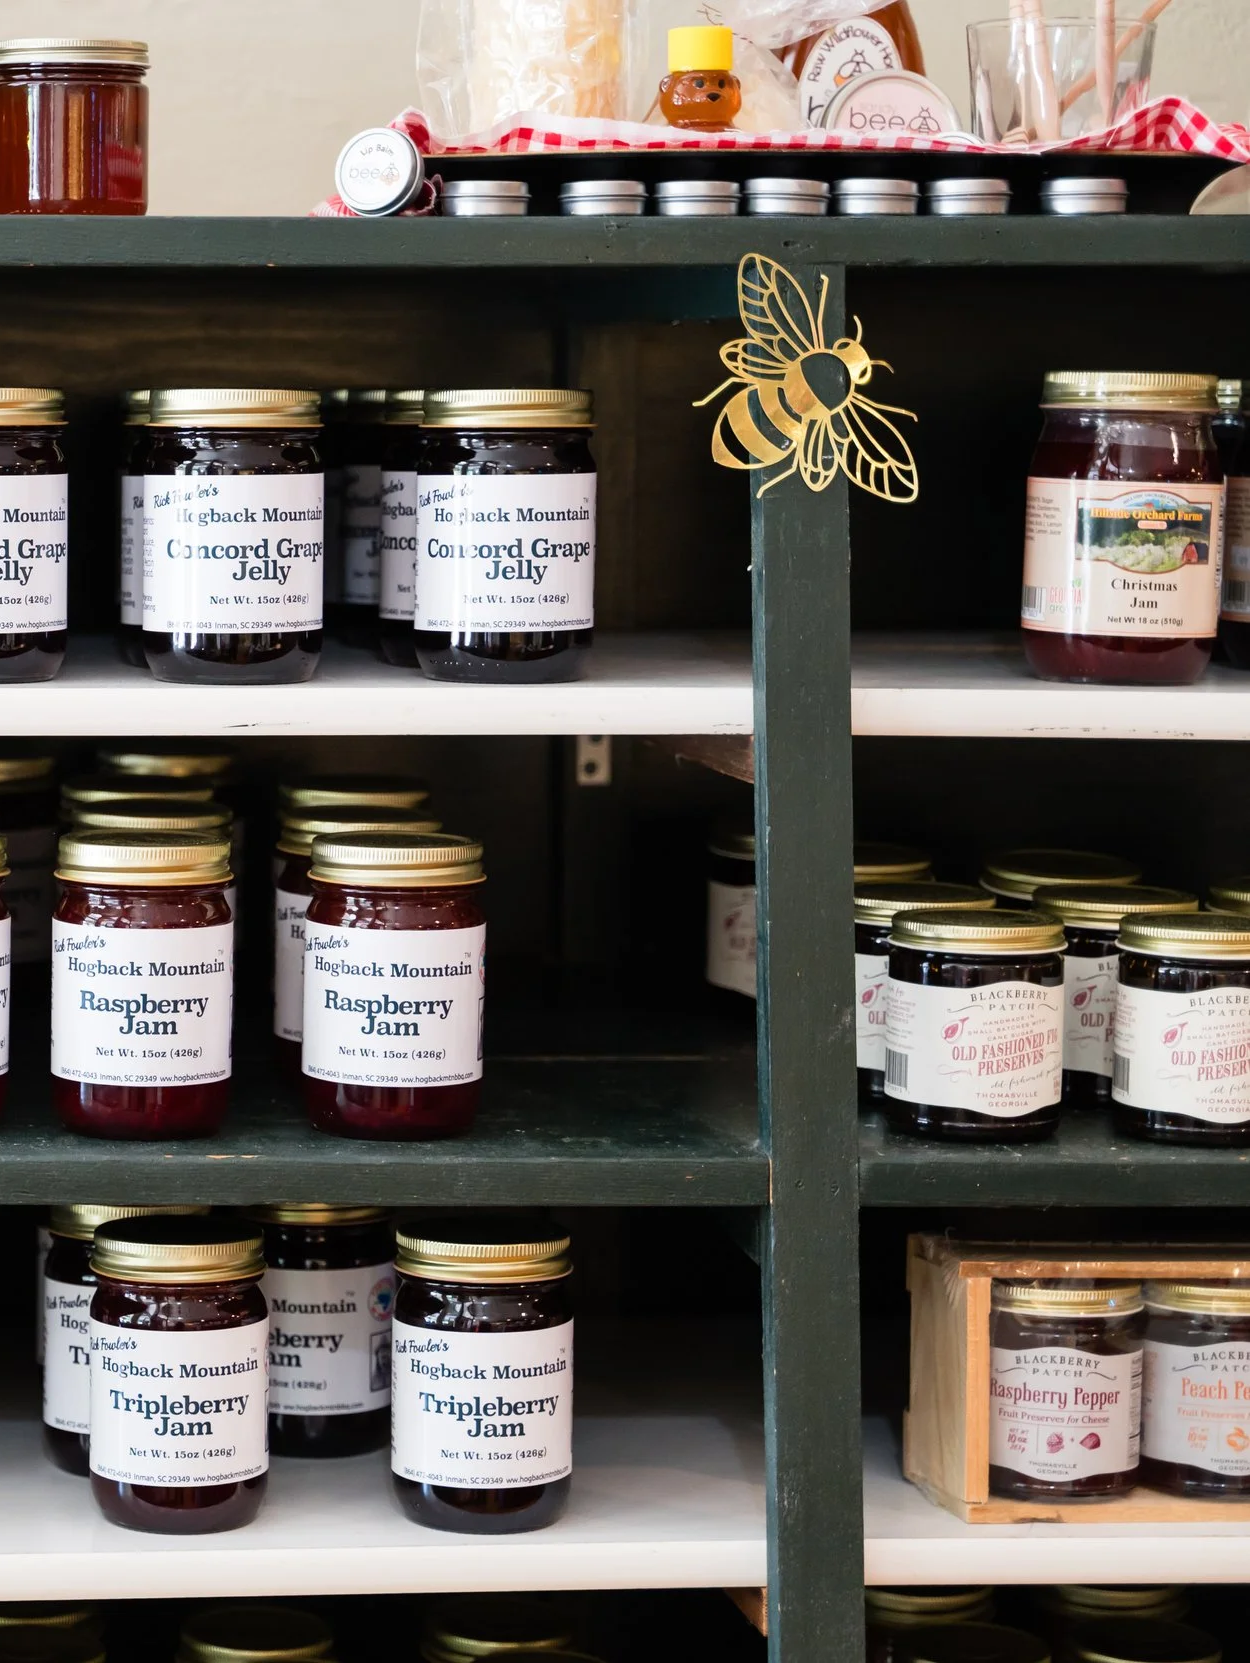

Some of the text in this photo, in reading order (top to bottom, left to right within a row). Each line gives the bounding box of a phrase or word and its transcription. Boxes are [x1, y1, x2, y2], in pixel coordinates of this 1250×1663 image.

[807, 25, 882, 82] Raw Wildflower
[850, 107, 905, 130] bee
[349, 165, 380, 178] bee
[262, 506, 322, 522] Mountain
[516, 506, 590, 522] Mountain
[1090, 507, 1203, 521] Hillside Orchard Farms
[17, 539, 66, 563] Grape
[167, 538, 270, 559] Concord
[428, 538, 590, 562] Concord Grape
[232, 560, 291, 585] Jelly
[485, 560, 547, 584] Jelly
[1111, 578, 1178, 592] Christmas
[510, 595, 535, 604] 15oz
[1130, 597, 1158, 609] Jam
[251, 621, 272, 629] 29349
[1107, 616, 1121, 624] Net
[1161, 617, 1183, 627] (510g)
[67, 936, 106, 950] Fowler's
[68, 957, 225, 977] Hogback Mountain
[315, 956, 472, 978] Hogback Mountain
[79, 990, 209, 1018] Raspberry
[324, 989, 453, 1019] Raspberry
[970, 989, 1049, 1002] BLACKBERRY
[989, 1003, 1035, 1011] PATCH
[119, 1016, 178, 1035] Jam
[361, 1016, 420, 1036] Jam
[952, 1046, 977, 1061] OLD
[981, 1033, 1045, 1060] FASHIONED
[978, 1049, 1044, 1076] PRESERVES
[1171, 1051, 1196, 1066] OLD
[975, 1091, 1038, 1099] THOMASVILLE
[100, 1336, 137, 1351] Fowler's
[102, 1356, 258, 1378] Hogback Mountain
[410, 1358, 567, 1381] Hogback Mountain
[1015, 1355, 1101, 1369] BLACKBERRY
[1032, 1368, 1083, 1378] PATCH
[990, 1376, 1120, 1410] Raspberry Pepper
[1181, 1377, 1227, 1400] Peach
[109, 1389, 249, 1420] Tripleberry
[419, 1391, 559, 1422] Tripleberry
[998, 1408, 1110, 1424] Fruit Preserves for Cheese
[154, 1417, 213, 1436] Jam
[467, 1418, 525, 1438] Jam
